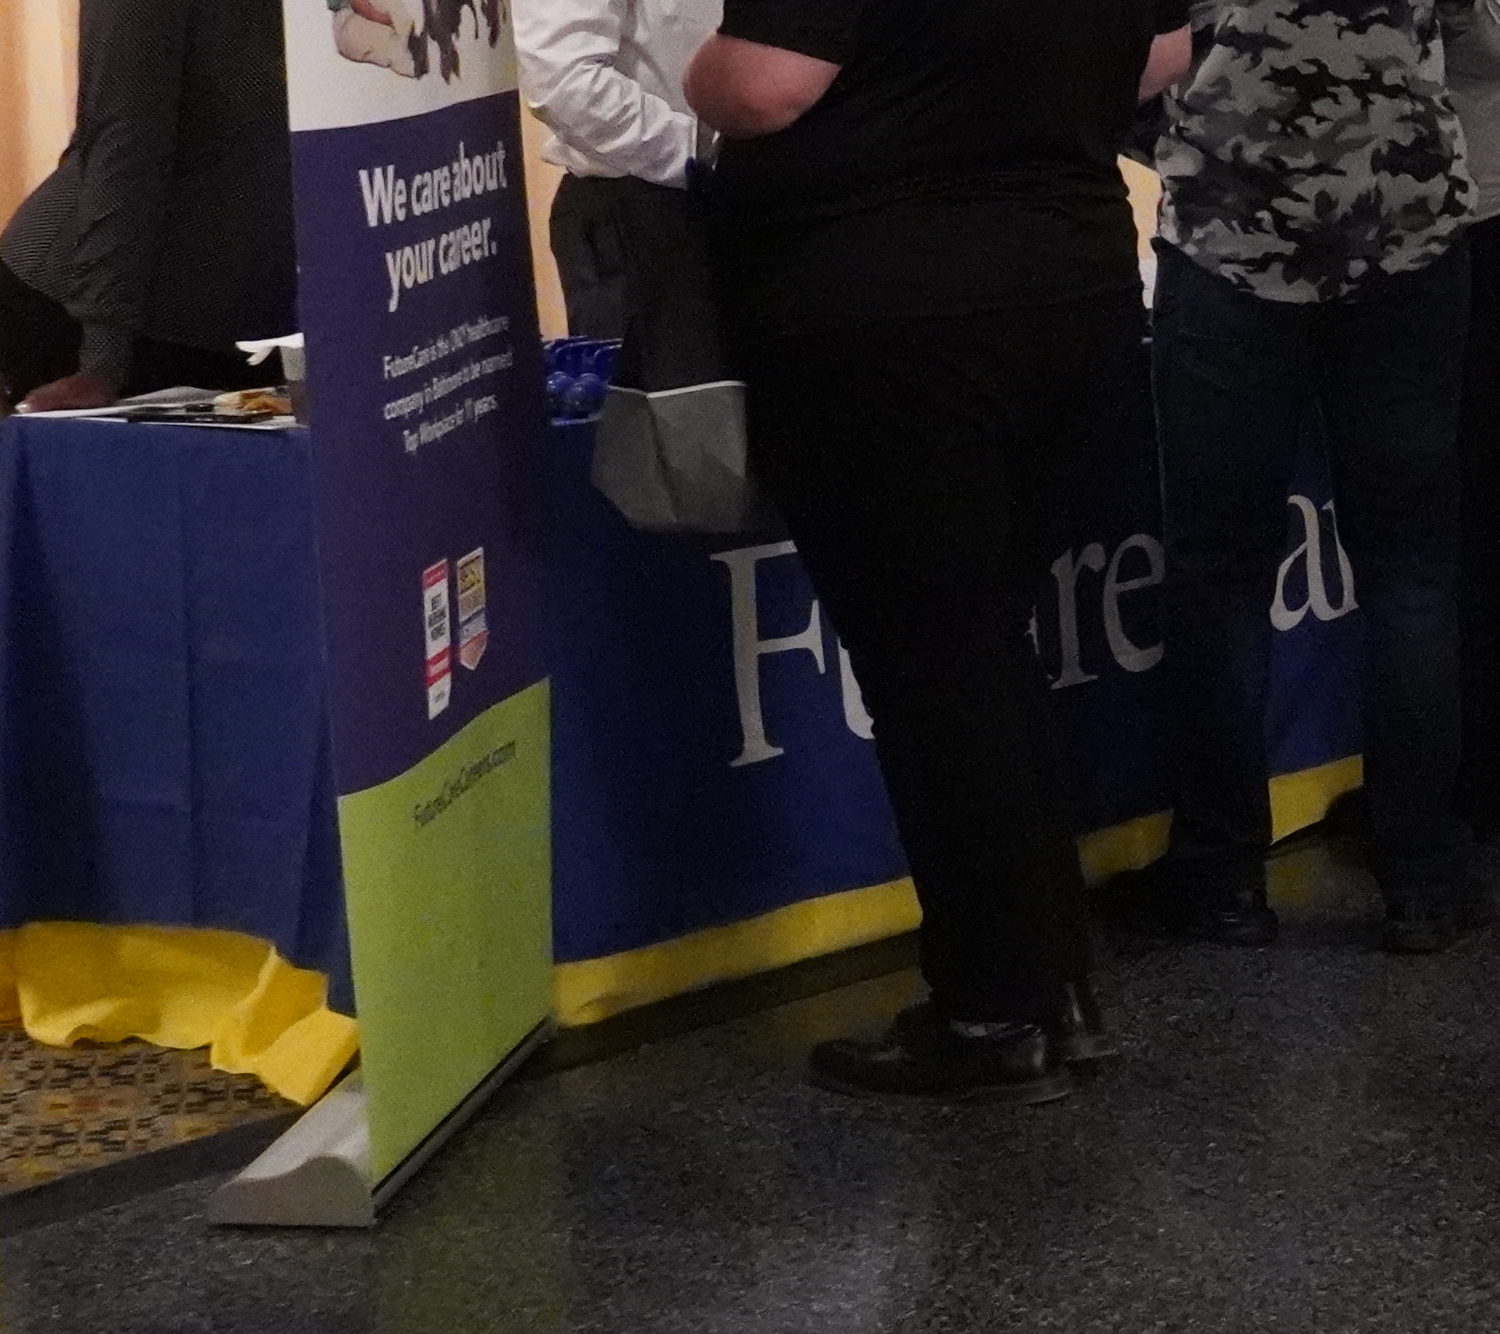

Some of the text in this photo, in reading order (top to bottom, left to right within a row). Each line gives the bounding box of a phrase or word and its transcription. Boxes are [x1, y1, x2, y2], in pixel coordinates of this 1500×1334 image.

[359, 140, 507, 228] We care about
[385, 216, 498, 313] your career.
